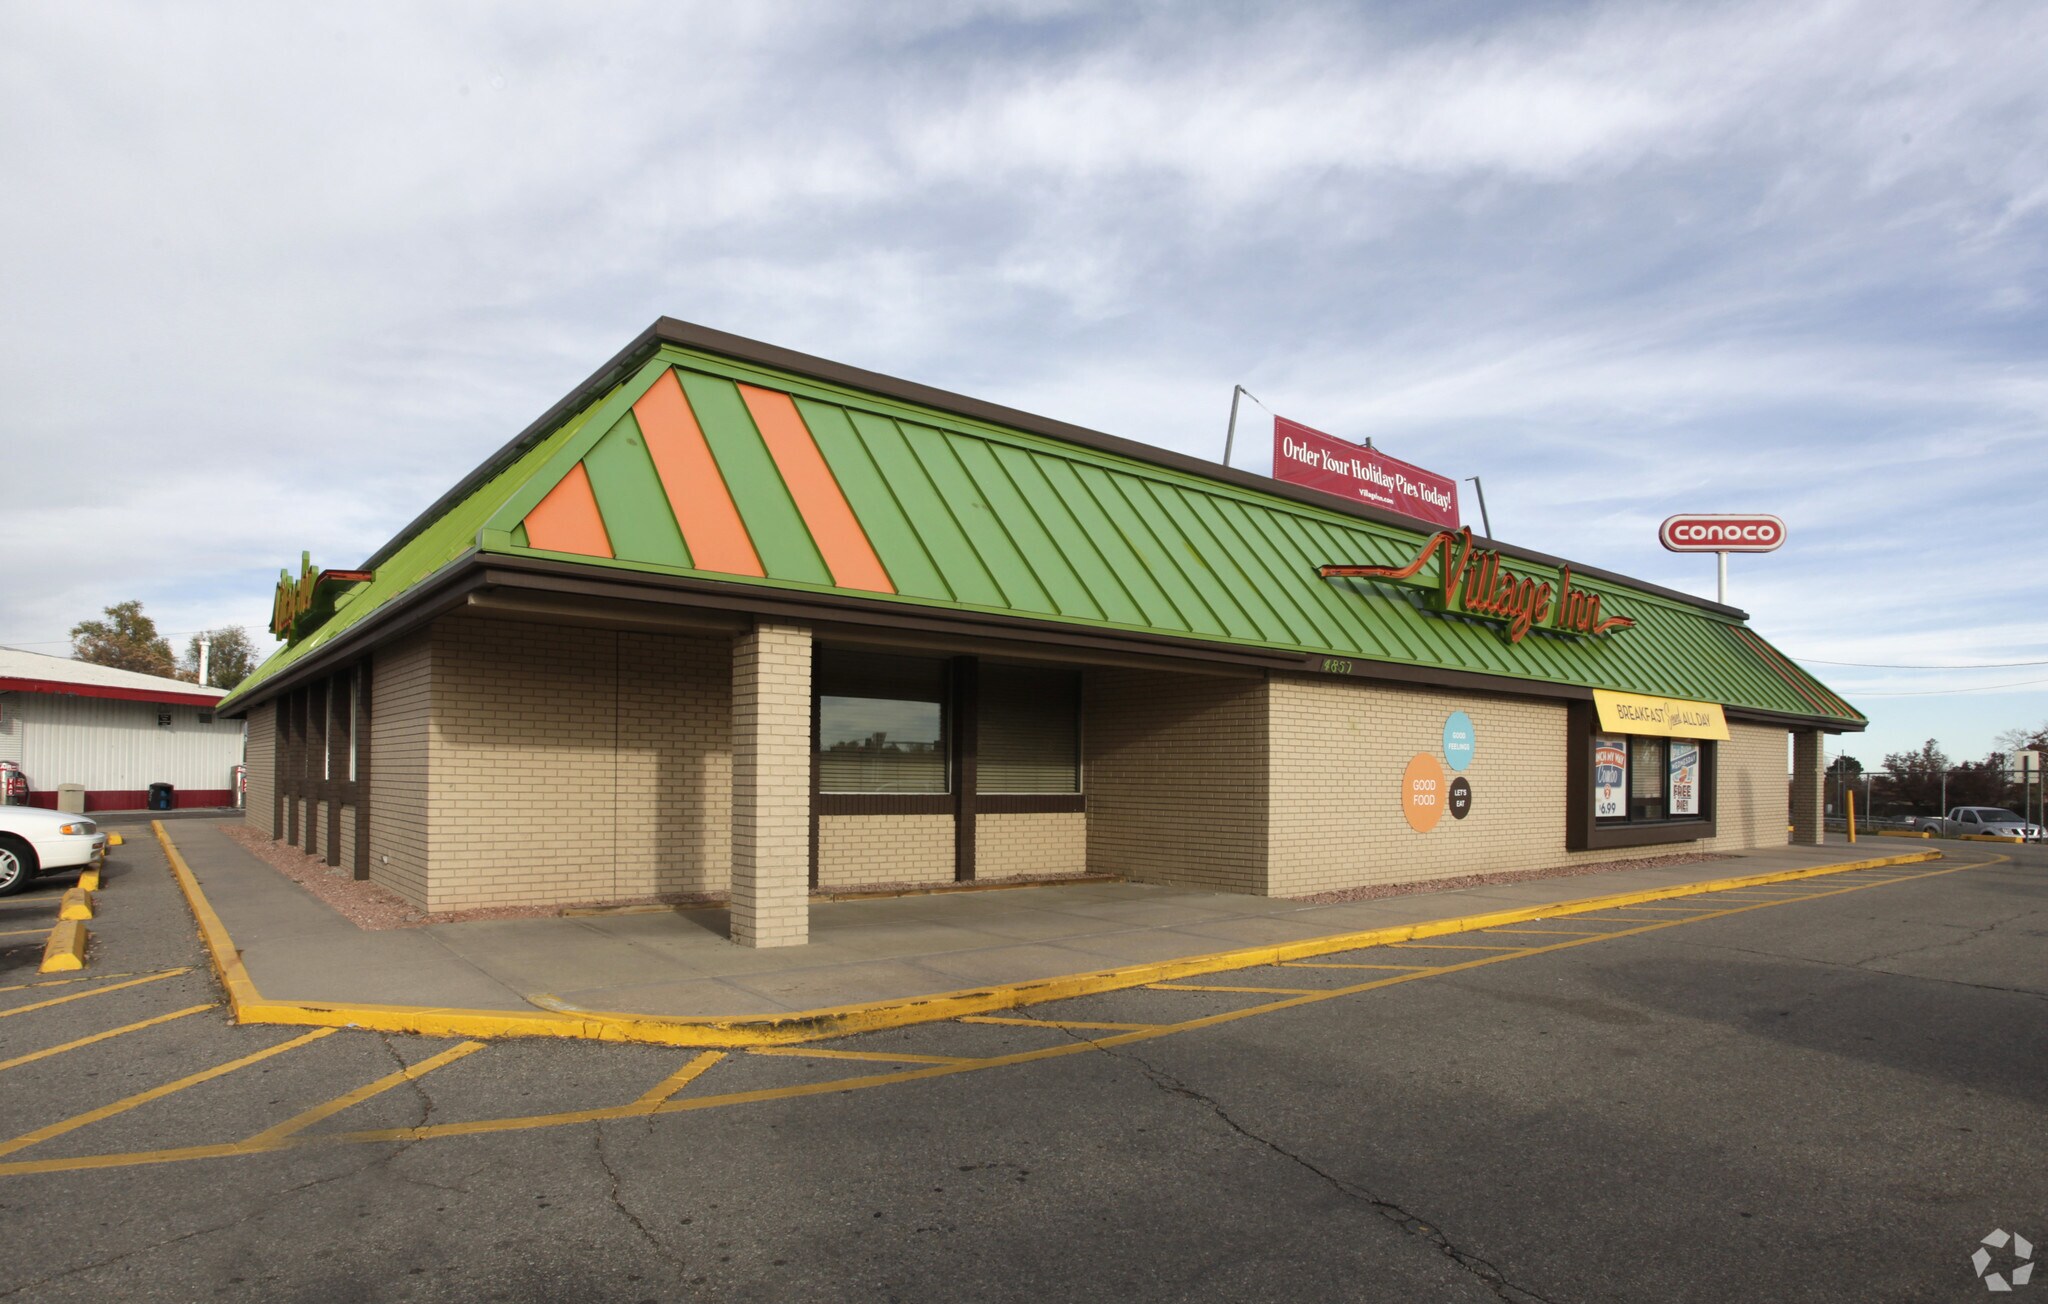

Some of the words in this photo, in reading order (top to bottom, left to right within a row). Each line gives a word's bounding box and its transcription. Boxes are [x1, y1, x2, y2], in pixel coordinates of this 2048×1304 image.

[1283, 436, 1320, 467] Order
[1321, 449, 1349, 475] Your
[1351, 458, 1394, 493] Holiday
[1395, 473, 1419, 497] Pies
[1418, 482, 1452, 512] Today!
[1395, 525, 1551, 644] Village
[1556, 563, 1618, 634] Inn
[1323, 658, 1352, 674] 4857
[1616, 704, 1665, 723] BREAKFAST
[1682, 711, 1697, 726] ALL
[1696, 712, 1711, 727] DAY
[1448, 742, 1470, 751] FEELINGS
[1596, 751, 1606, 762] NCH
[1607, 751, 1615, 762] MY
[1413, 779, 1436, 791] GOOD
[1673, 784, 1692, 800] FREE
[1413, 794, 1436, 806] FOOD
